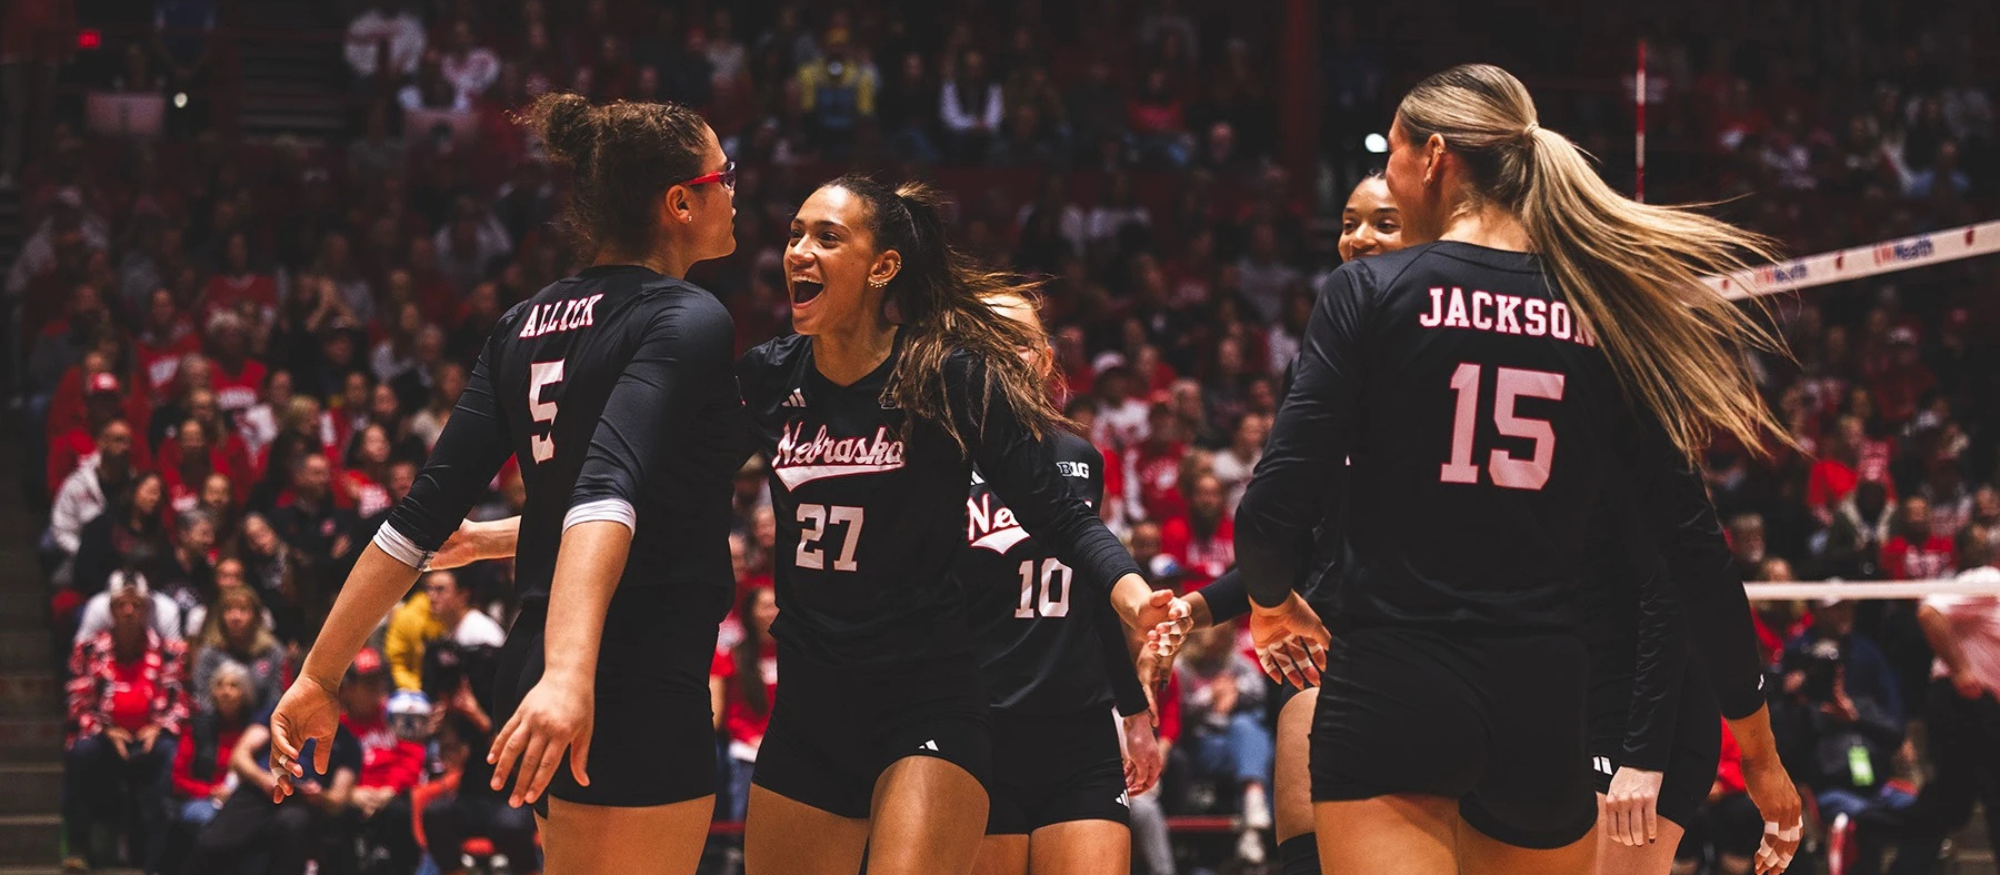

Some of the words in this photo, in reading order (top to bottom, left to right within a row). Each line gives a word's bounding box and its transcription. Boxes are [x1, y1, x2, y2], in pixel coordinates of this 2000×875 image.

[519, 293, 604, 338] ALLICK
[528, 357, 566, 465] 5
[771, 420, 905, 467] Nebraska
[1440, 362, 1566, 491] 15
[795, 502, 865, 573] 27
[1014, 557, 1074, 619] 10
